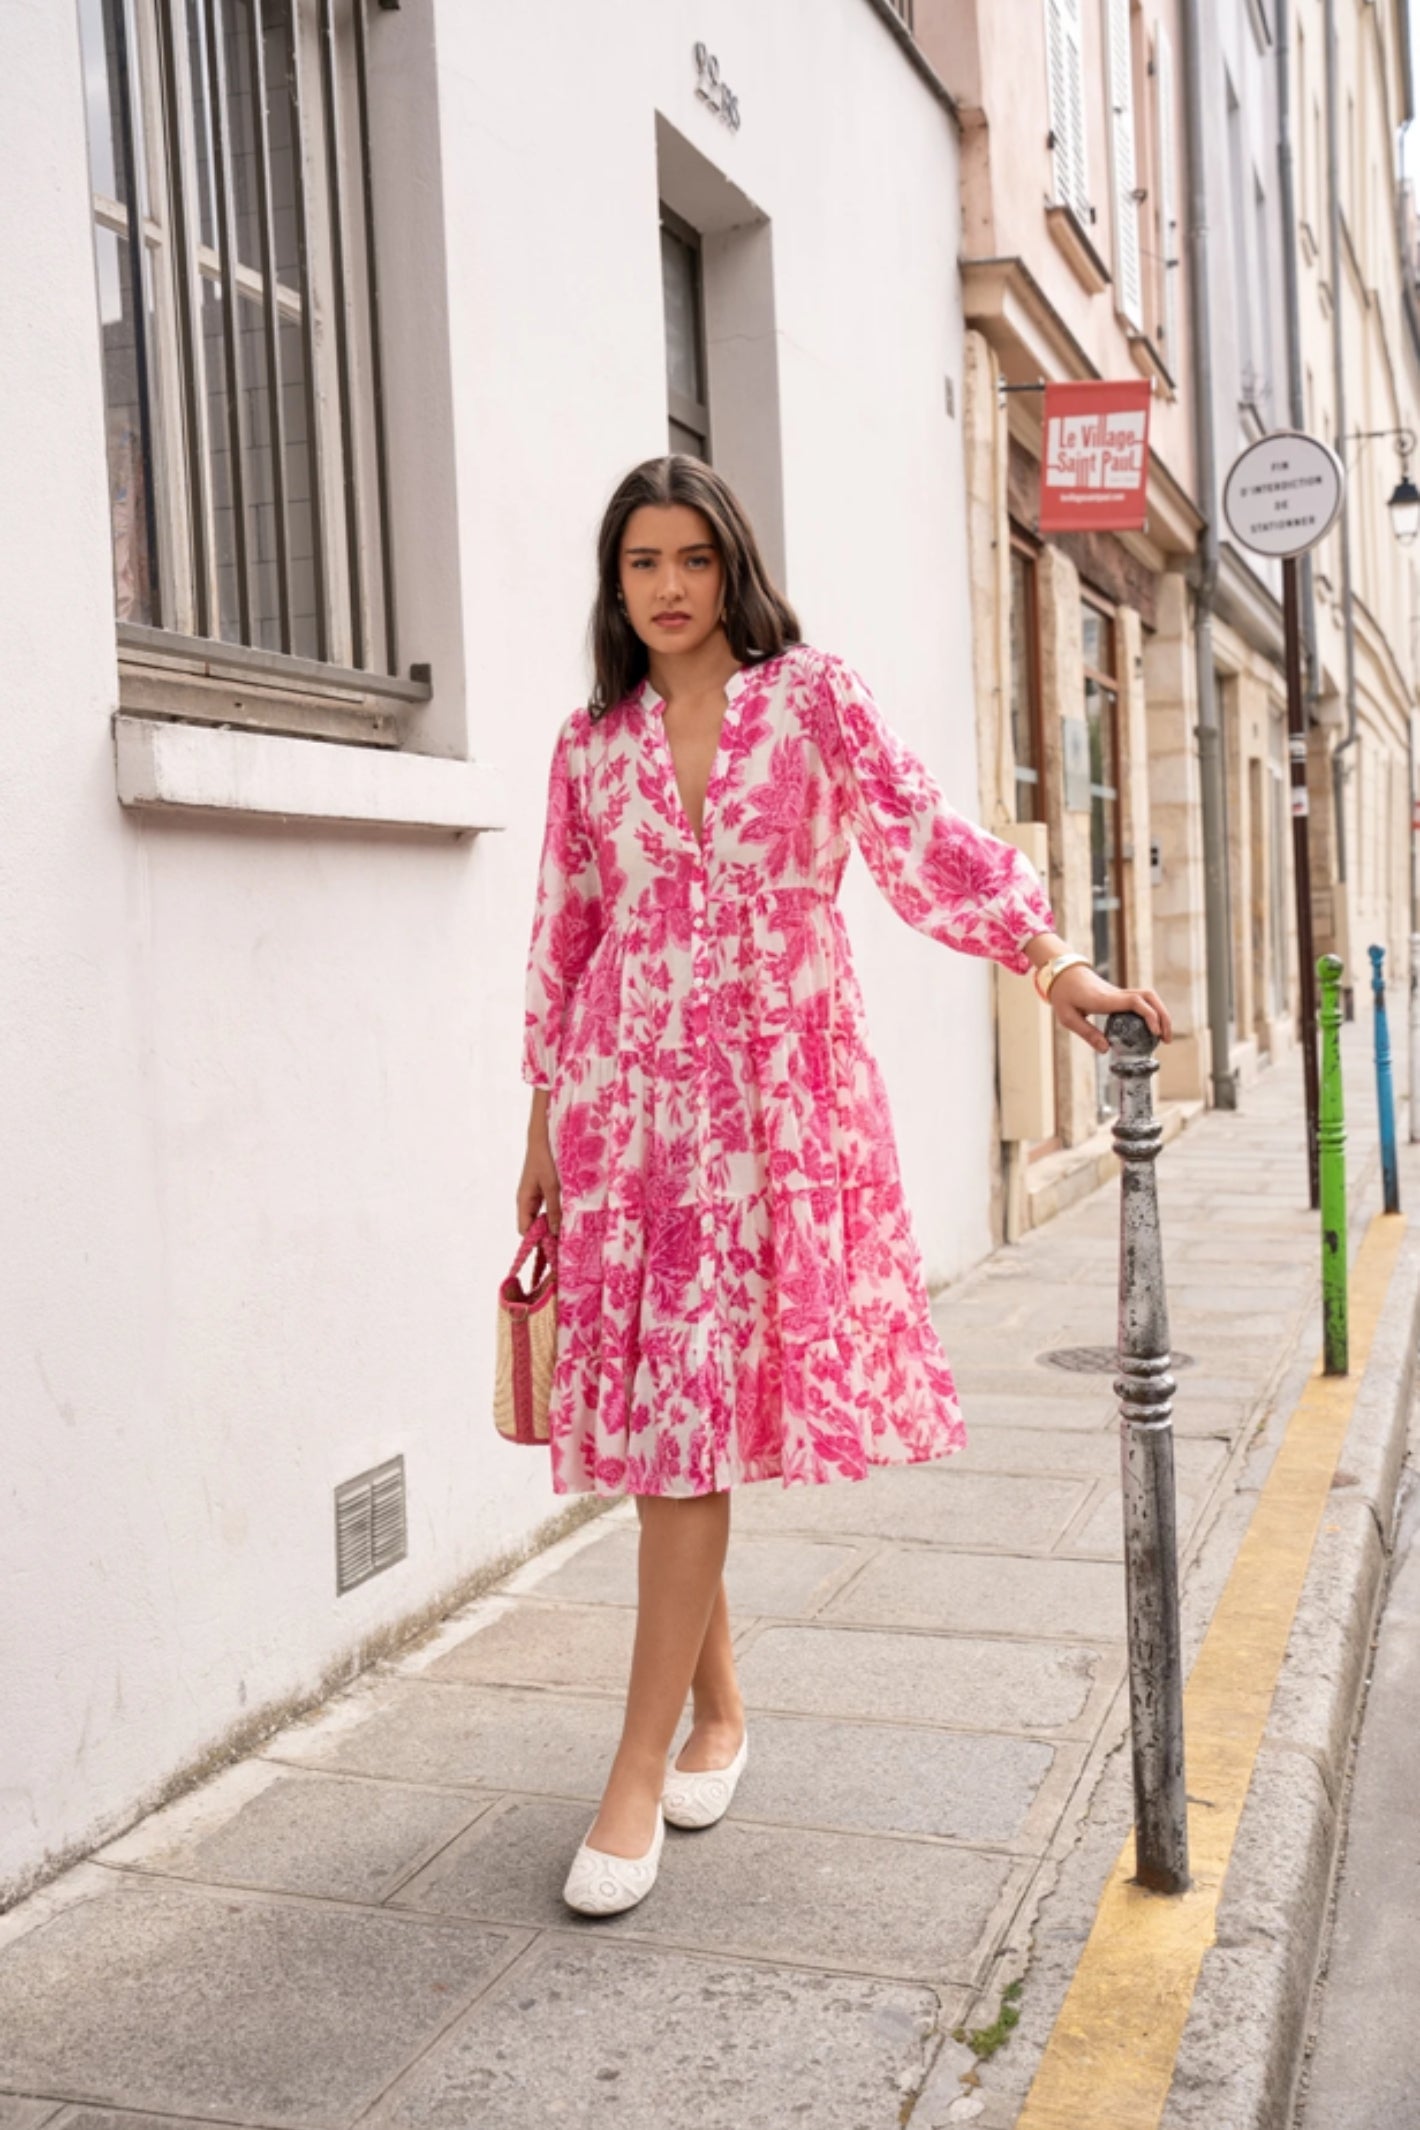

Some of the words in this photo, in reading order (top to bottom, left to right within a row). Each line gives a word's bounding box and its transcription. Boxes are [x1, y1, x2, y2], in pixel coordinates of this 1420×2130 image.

[1059, 424, 1076, 449] Le
[1081, 422, 1136, 451] Village
[1057, 451, 1096, 473] Saint
[1102, 449, 1137, 472] Paul
